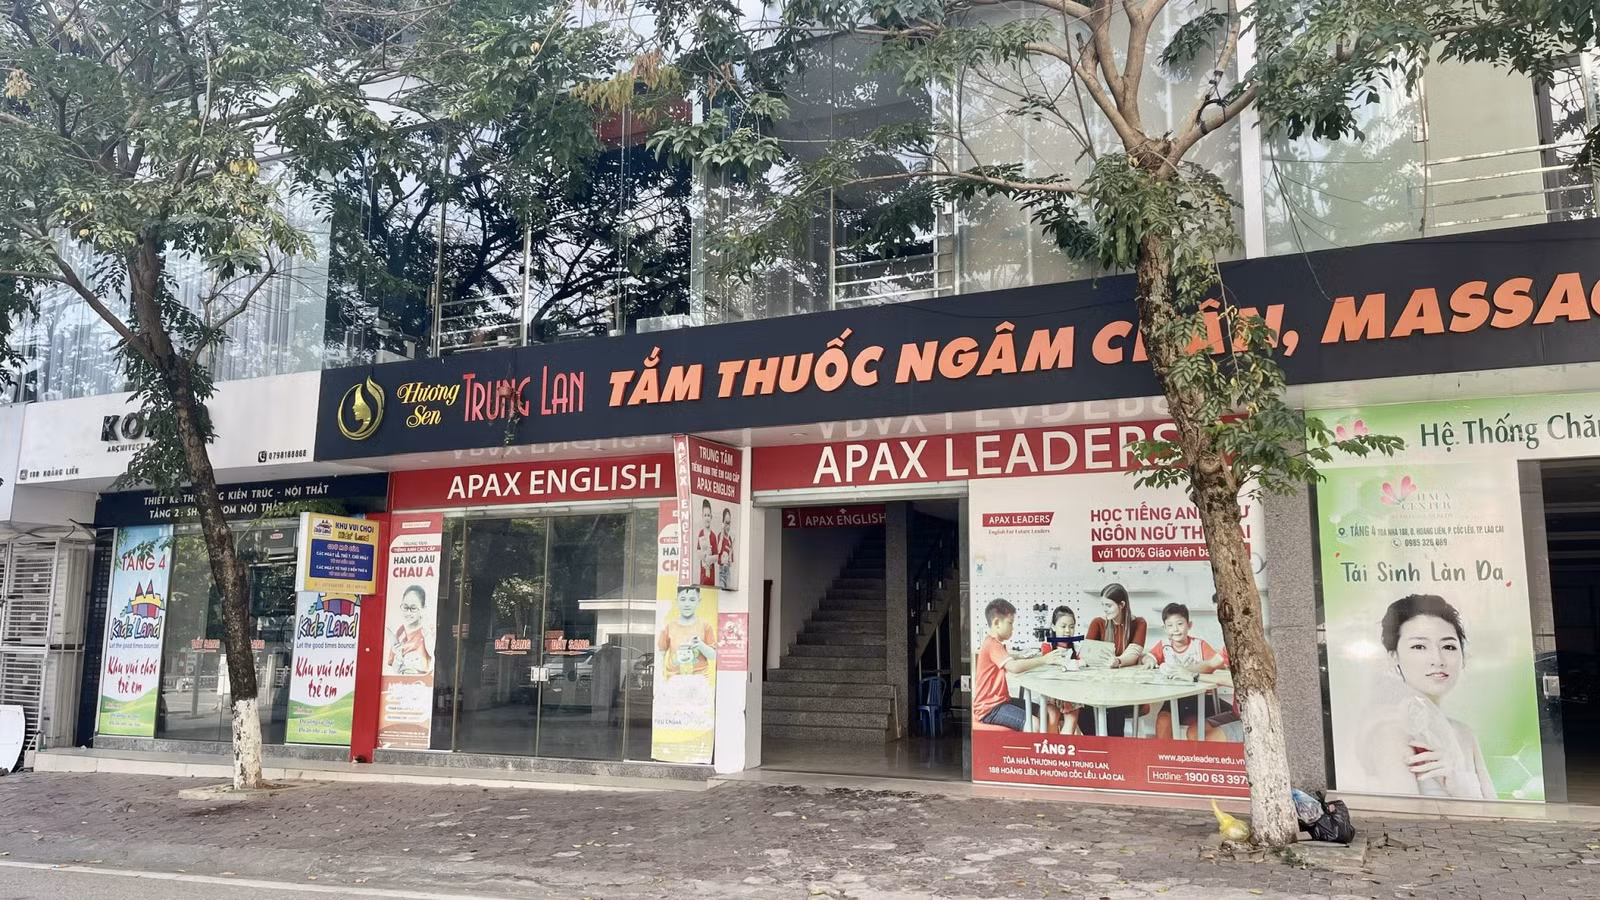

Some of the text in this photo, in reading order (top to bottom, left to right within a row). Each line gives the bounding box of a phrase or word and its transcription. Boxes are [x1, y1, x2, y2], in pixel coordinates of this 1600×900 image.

[609, 346, 703, 407] TẮM
[718, 327, 884, 398] THUỐC
[895, 320, 1075, 384] NGÂM
[1320, 272, 1600, 344] MASSA
[397, 381, 460, 406] Hương
[541, 365, 584, 415] LAN
[406, 404, 441, 428] Sen
[1421, 411, 1600, 452] Hệ Thống Chă
[699, 446, 733, 466] TRUNG TÂM
[813, 440, 928, 484] APAX
[447, 463, 661, 500] APAX ENGLISH
[697, 477, 735, 498] APAX ENGLISH
[228, 488, 247, 500] KIẾN
[252, 487, 274, 498] TRÚC
[285, 485, 301, 497] NỘI
[306, 482, 329, 495] THẤT
[787, 512, 886, 527] 2 APAX ENGLISH
[989, 514, 1050, 524] APAX LEADERS
[1091, 508, 1122, 526] HỌC
[1125, 501, 1171, 521] TIẾNG
[335, 522, 347, 530] KHU
[1091, 523, 1136, 541] NGÔN
[1141, 523, 1177, 541] NGỮ
[680, 500, 690, 579] ENGLISH
[1098, 547, 1113, 558] với
[1115, 547, 1145, 559] 100%
[1148, 546, 1171, 558] Giáo
[1175, 546, 1195, 557] viên
[159, 554, 166, 570] 4
[1340, 559, 1503, 583] Tái Sinh Làn Da
[312, 642, 324, 650] good
[568, 639, 589, 650] SANG
[108, 655, 123, 675] Khu
[125, 659, 139, 674] vui
[295, 655, 354, 678] Khu vui chơi
[131, 681, 142, 694] em
[324, 685, 337, 698] em
[1034, 739, 1076, 756] TẦNG 2
[1016, 756, 1030, 765] NHÀ
[1071, 761, 1094, 769] TRUNG
[1158, 754, 1245, 765] www.apaxleaders.edu.vn
[1152, 770, 1183, 781] Hotline:
[1185, 772, 1209, 782] 1900
[1211, 774, 1225, 783] 63
